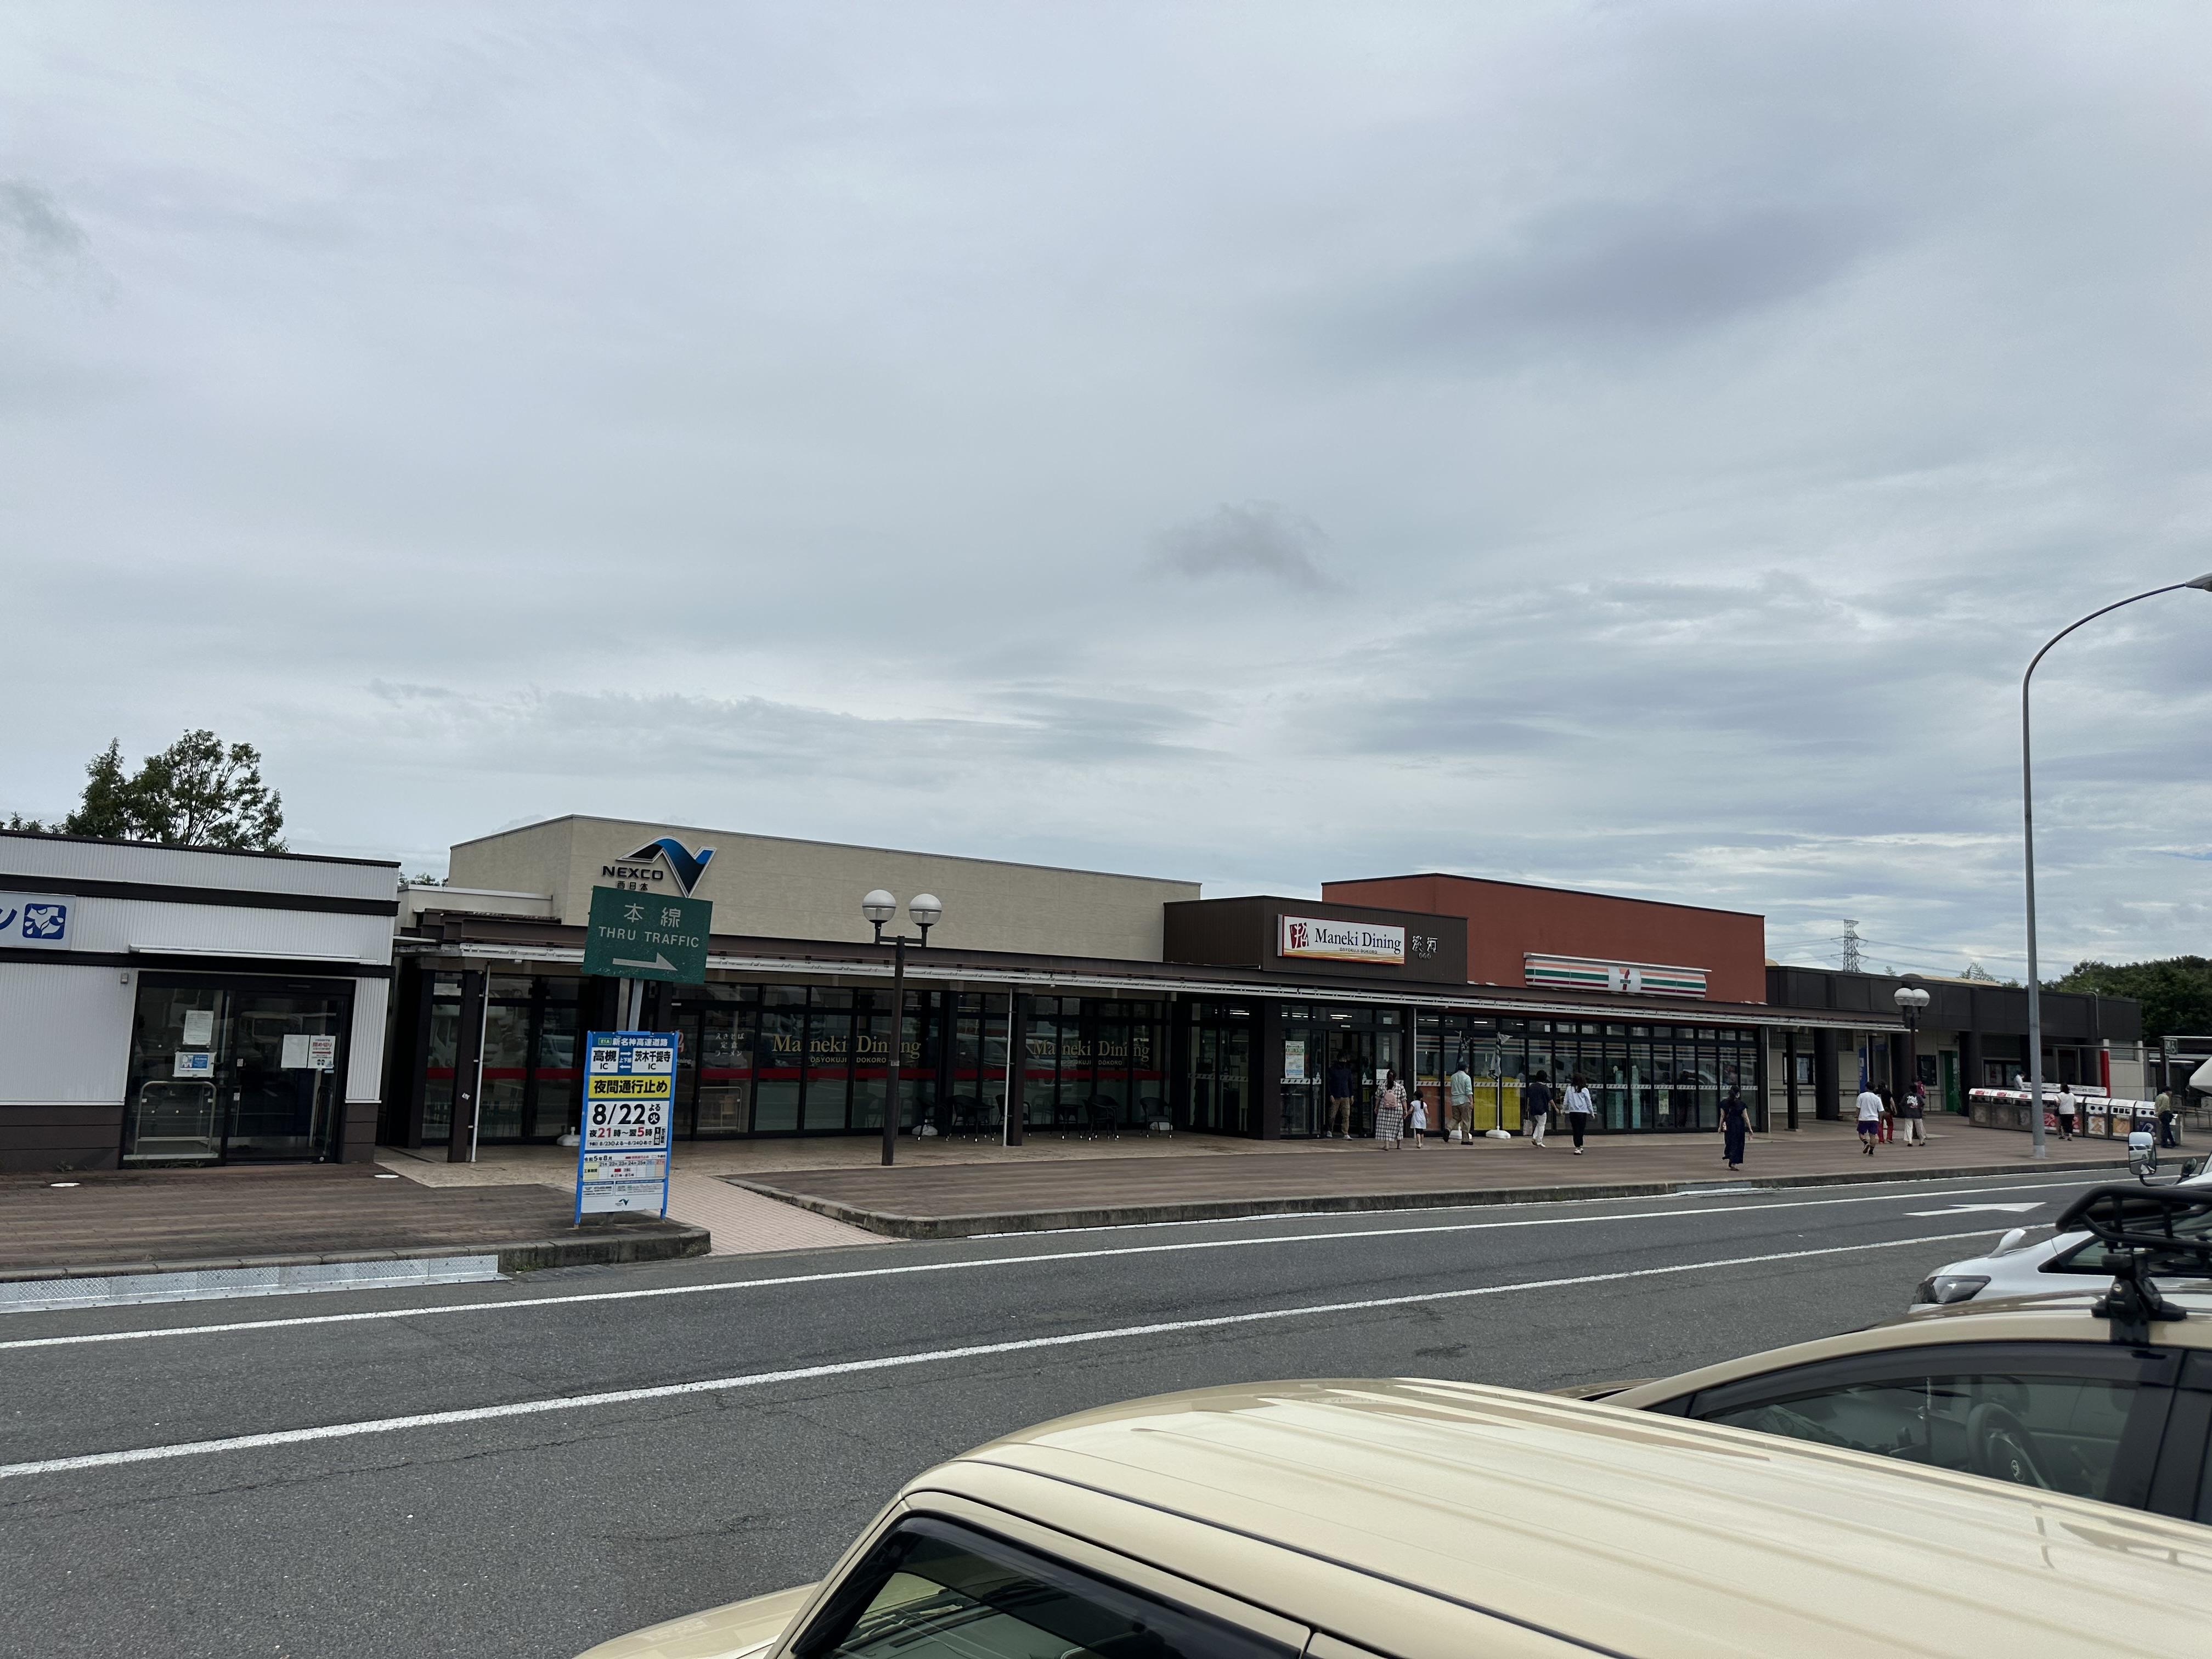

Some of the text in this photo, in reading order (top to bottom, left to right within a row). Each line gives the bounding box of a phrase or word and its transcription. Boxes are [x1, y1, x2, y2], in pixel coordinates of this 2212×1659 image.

[602, 865, 664, 880] NEXCO
[617, 880, 648, 891] 西日本
[624, 903, 681, 928] 本線
[599, 926, 699, 948] THRU TRAFFIC
[1315, 928, 1402, 955] Maneki Dining
[1412, 935, 1438, 953] 淡河
[612, 1038, 668, 1046] 新名神高速道路
[772, 1034, 922, 1059] Maneki Dinng
[593, 1050, 617, 1062] 高槻
[634, 1051, 671, 1063] 茨木千提寺
[1033, 1040, 1150, 1062] Maneki Dining
[594, 1080, 668, 1094] 夜間通行止め
[592, 1104, 646, 1125] 8/22
[649, 1113, 659, 1123] 火
